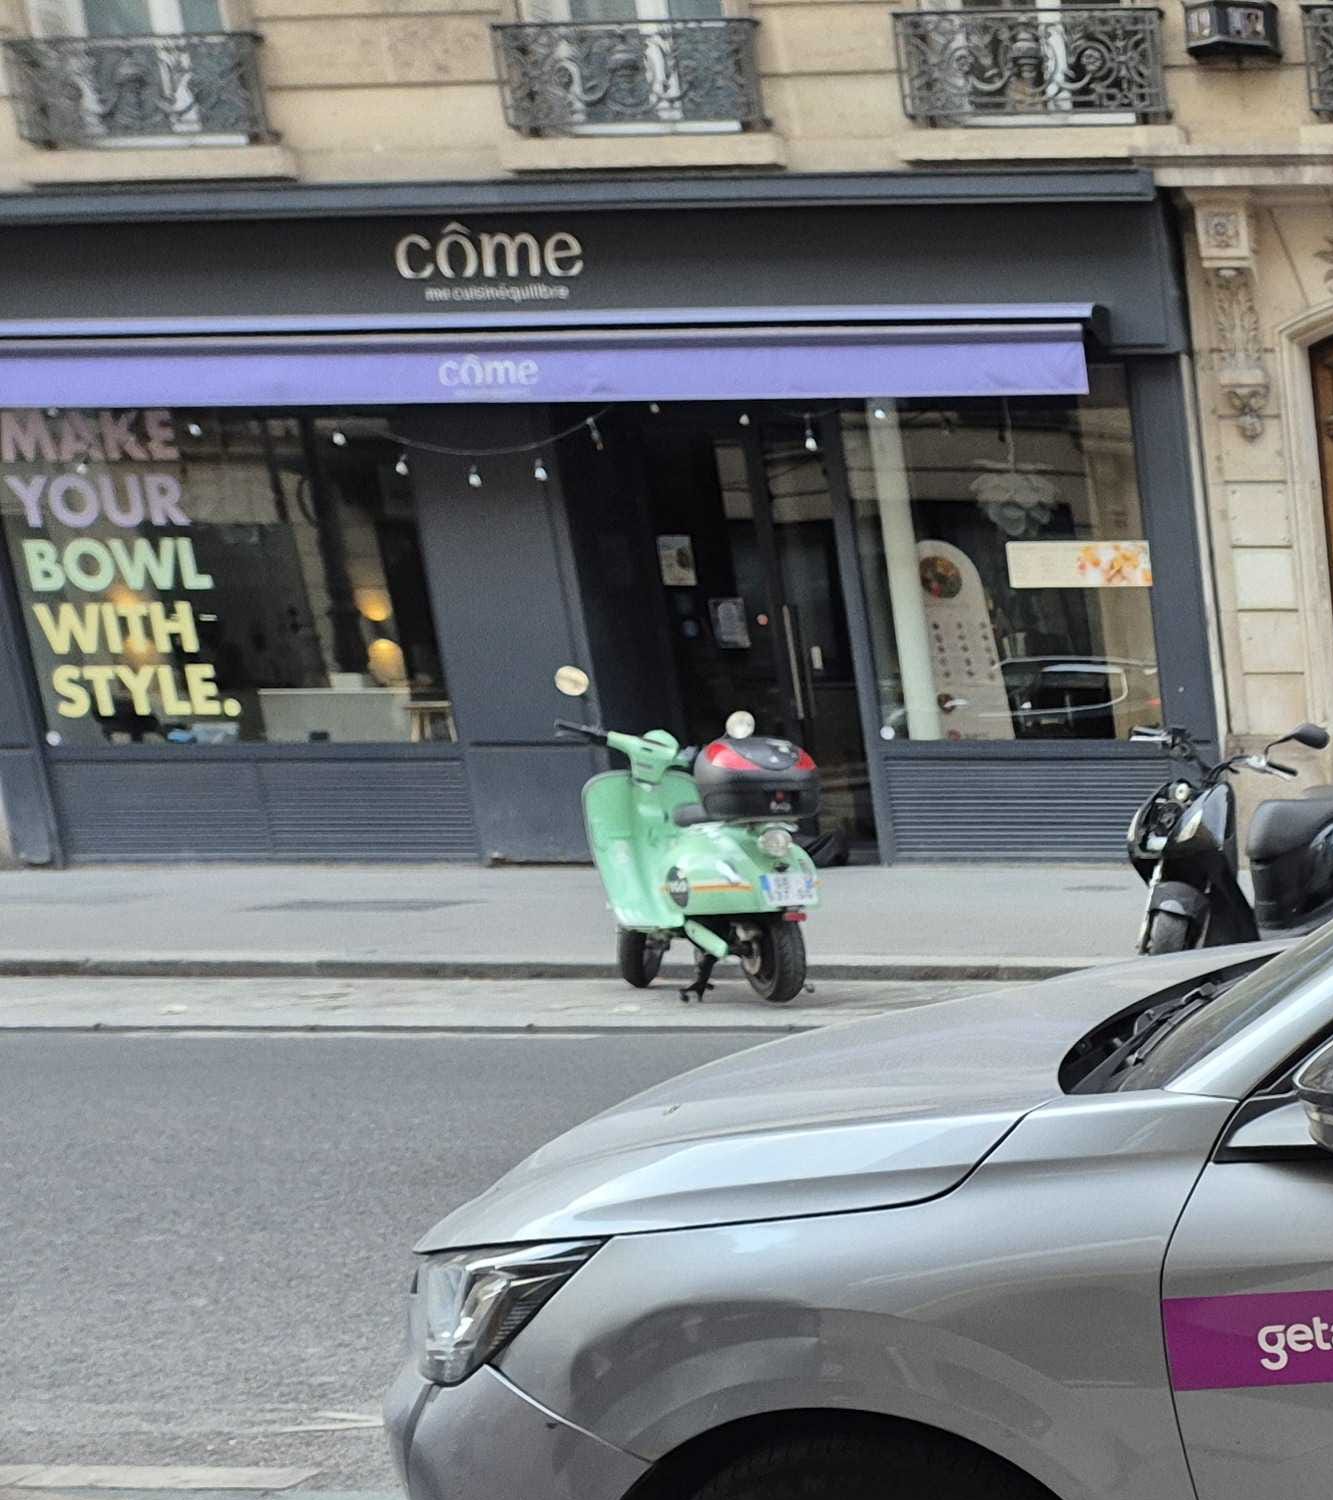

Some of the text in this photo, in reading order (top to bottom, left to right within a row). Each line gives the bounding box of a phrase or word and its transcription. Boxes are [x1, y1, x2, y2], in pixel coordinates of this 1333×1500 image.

[395, 221, 585, 279] côme
[438, 353, 540, 387] côme
[0, 409, 182, 463] MAKE
[4, 473, 193, 528] YOUR
[22, 536, 215, 592] BOWL
[32, 601, 201, 655] WITH
[52, 664, 242, 718] STYLE.
